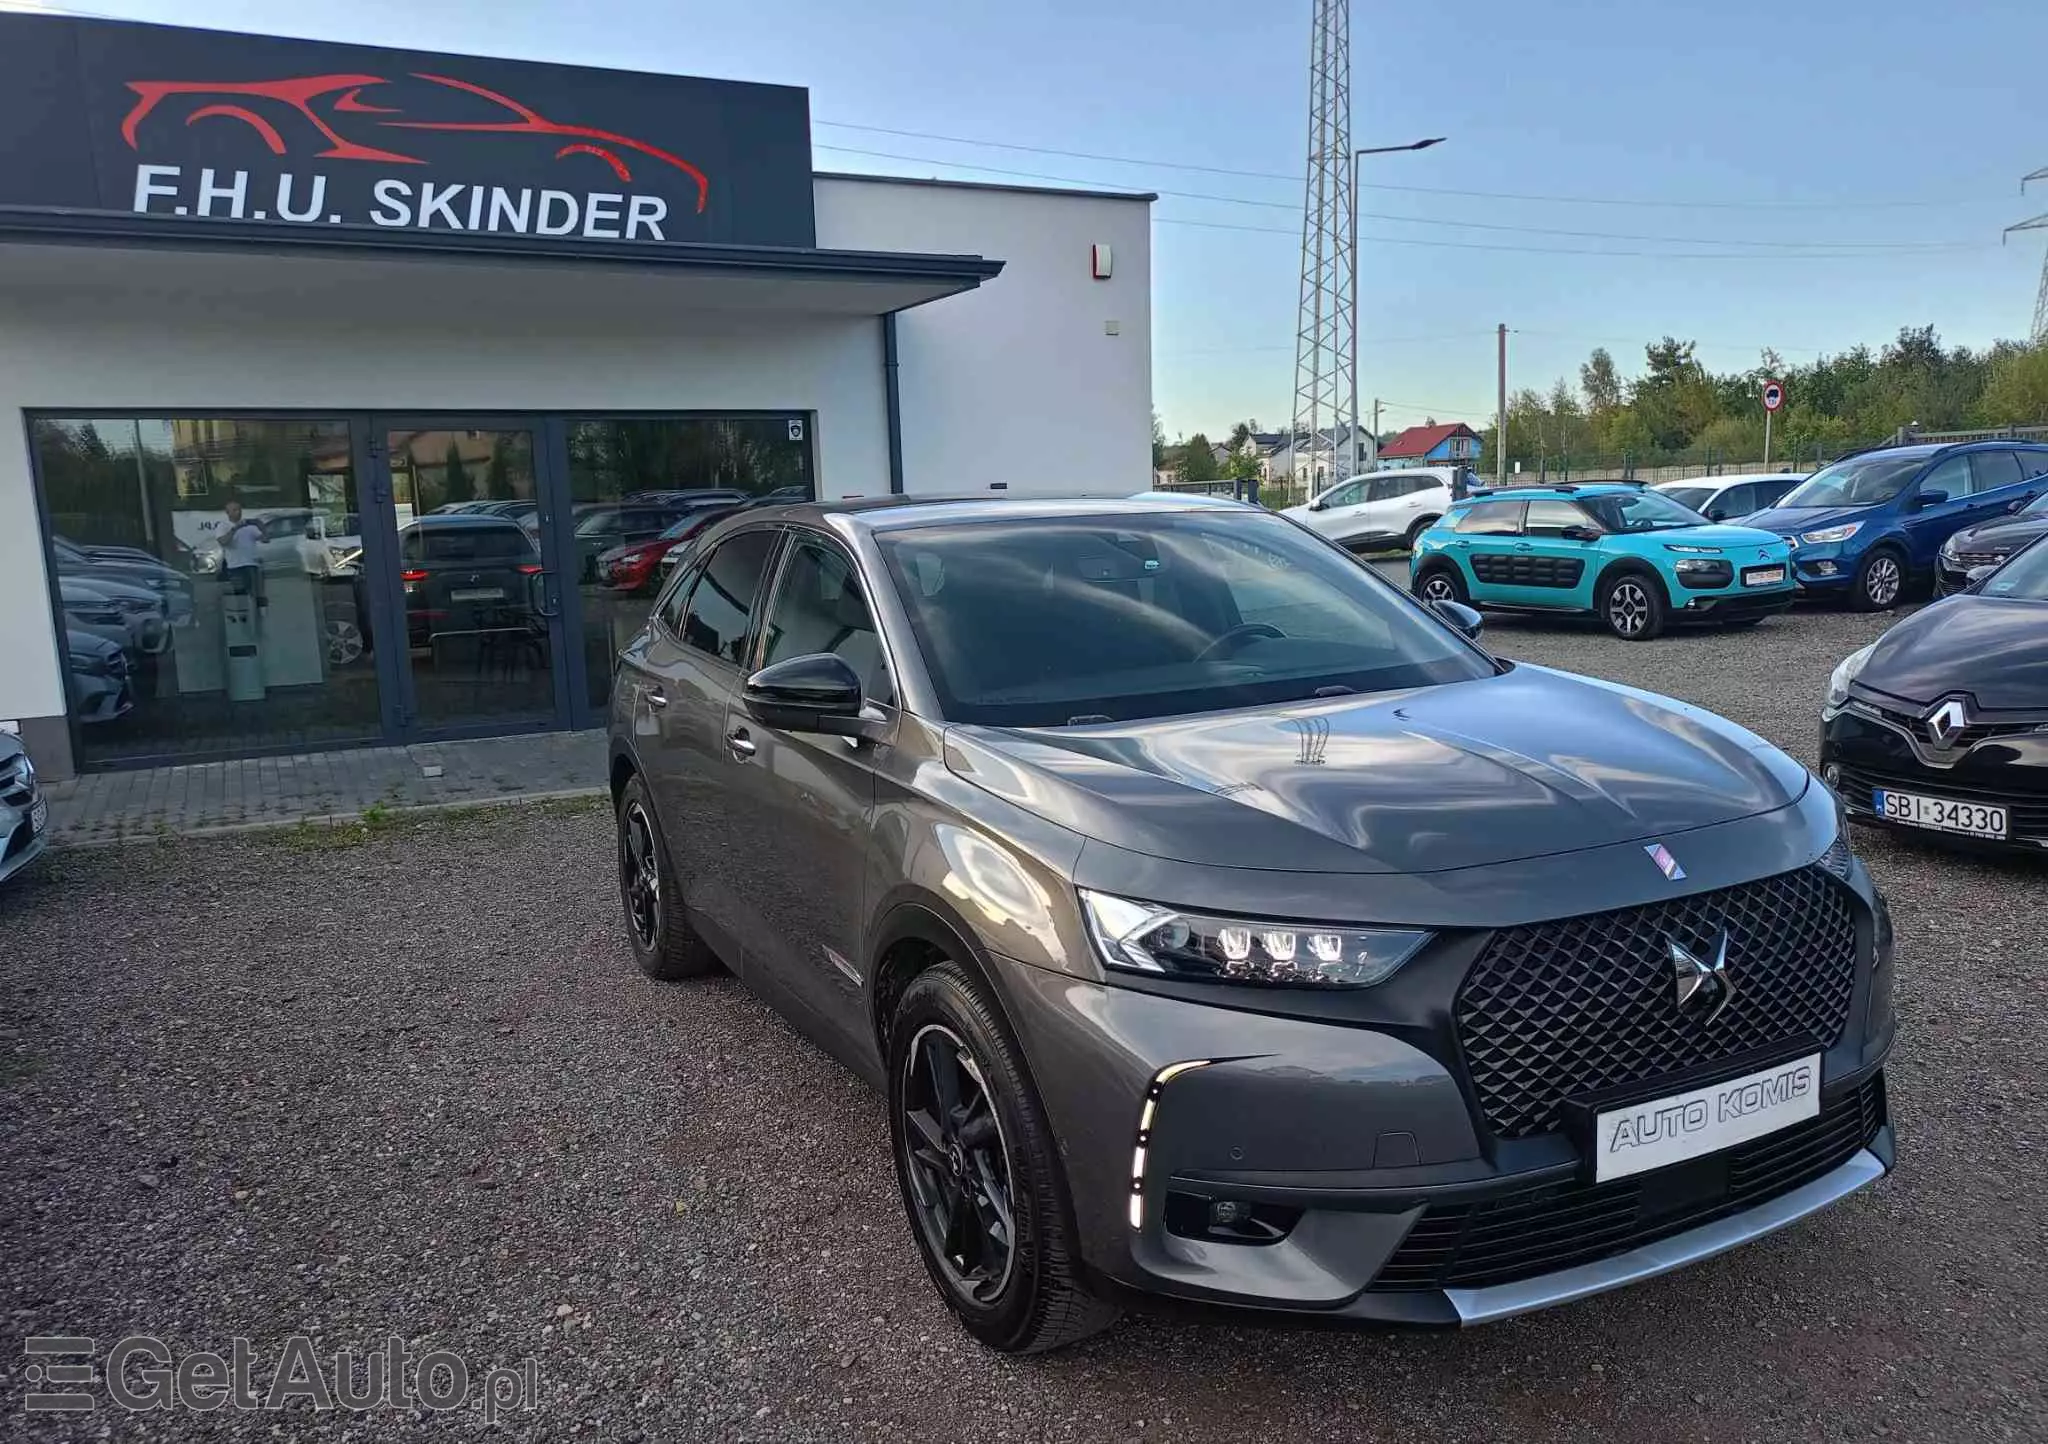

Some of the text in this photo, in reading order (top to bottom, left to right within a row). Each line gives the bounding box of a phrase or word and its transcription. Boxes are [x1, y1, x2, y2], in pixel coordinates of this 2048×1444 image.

[133, 164, 669, 241] F.H.U. SKINDER
[1885, 793, 1921, 821] SBI
[1932, 801, 2004, 833] 34330
[1609, 1065, 1812, 1153] AUTO KOMIS
